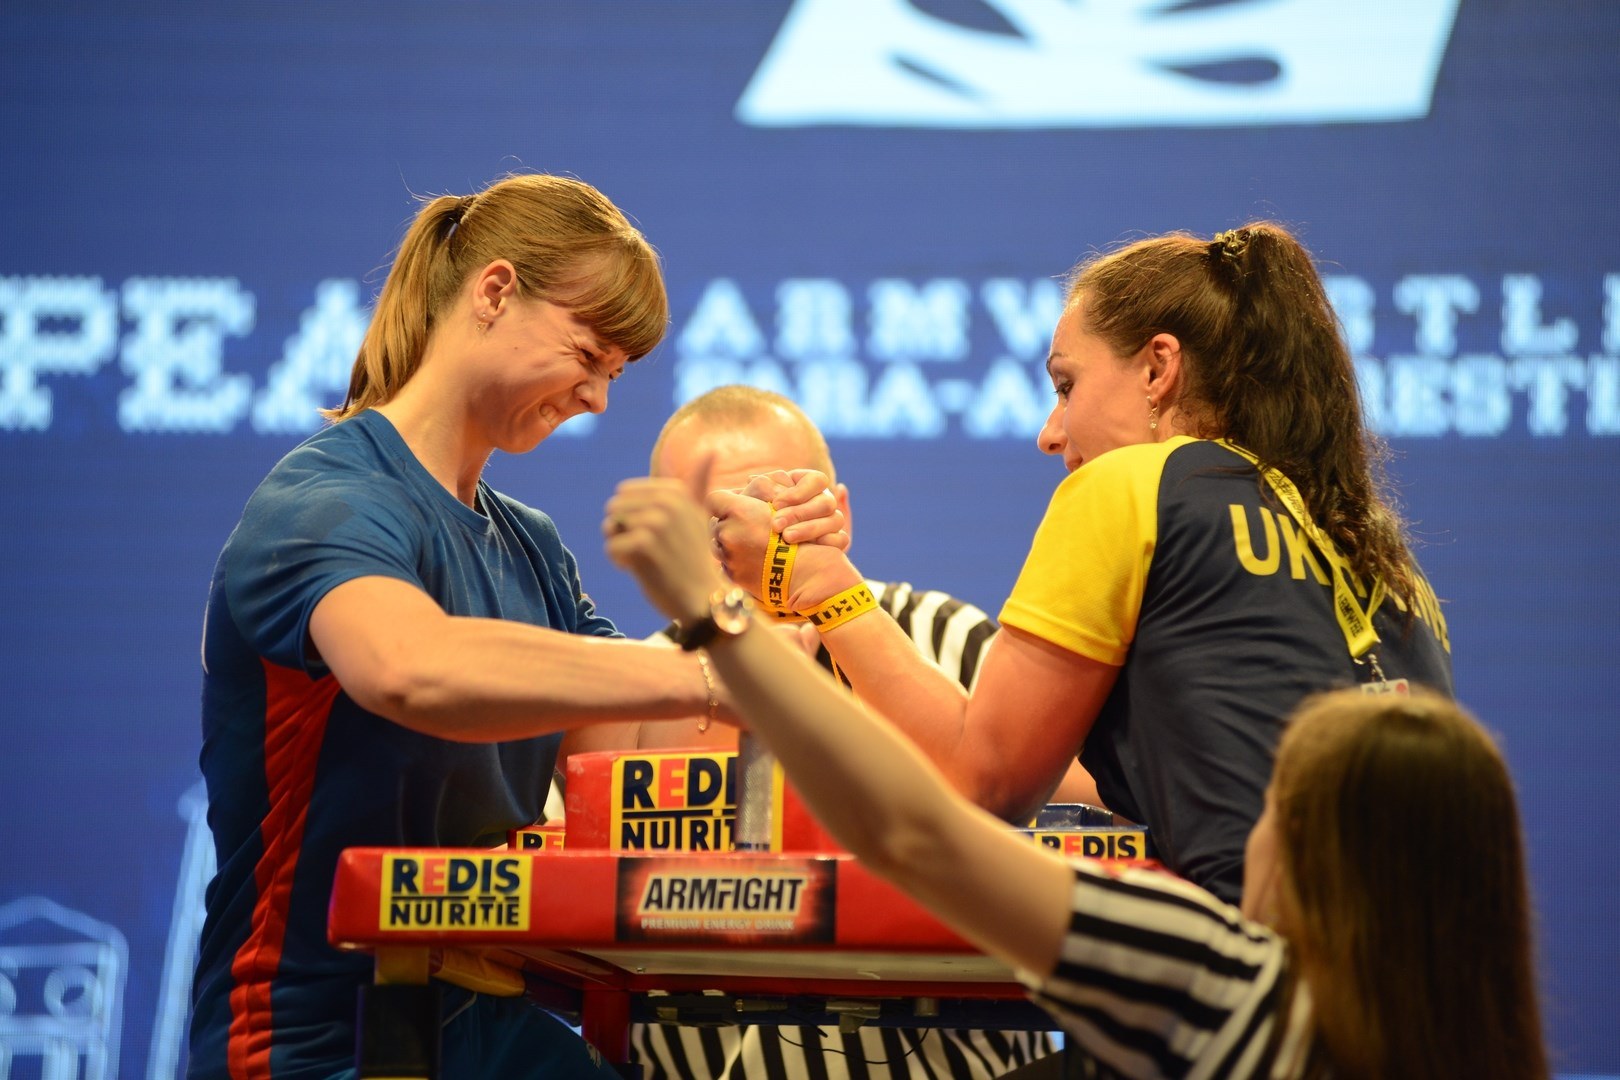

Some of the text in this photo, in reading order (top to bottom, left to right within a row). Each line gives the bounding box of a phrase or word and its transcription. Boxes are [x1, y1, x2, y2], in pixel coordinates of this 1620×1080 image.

[622, 757, 737, 809] REDI
[392, 858, 520, 895] REDIS
[643, 877, 803, 912] ARMFIGHT
[390, 900, 519, 926] NUTRITIE
[641, 918, 794, 931] PREMIUM ENERGY DRINK
